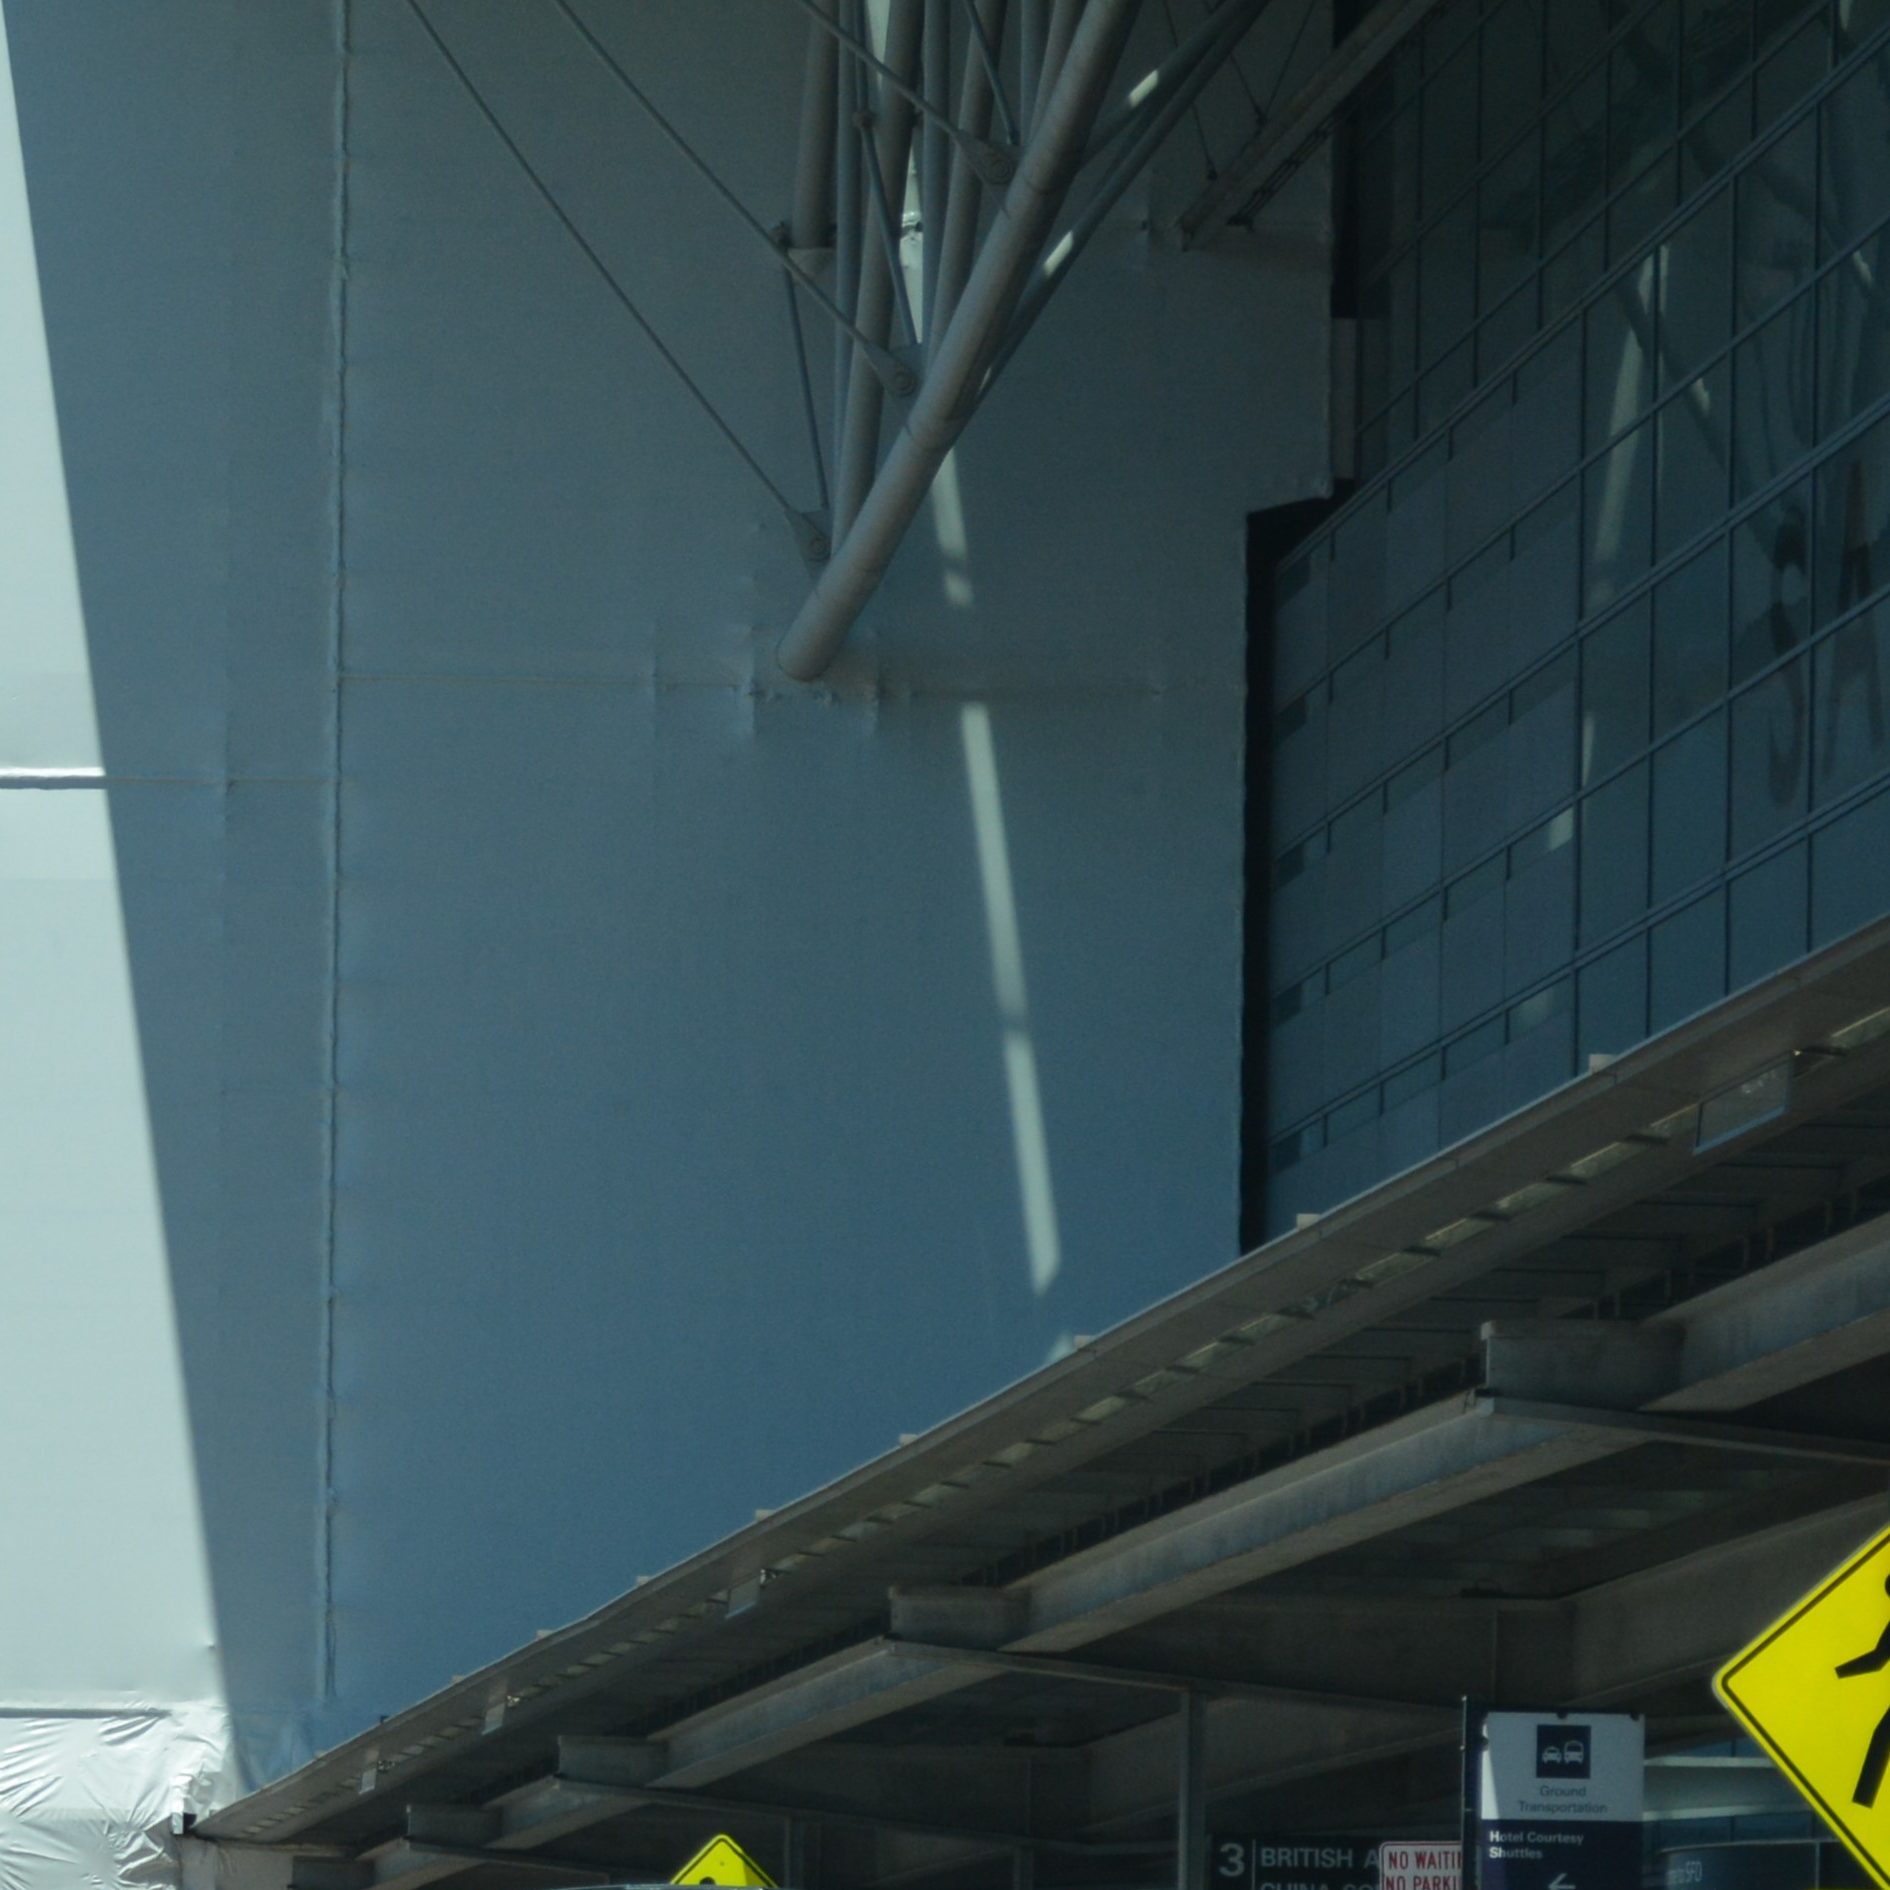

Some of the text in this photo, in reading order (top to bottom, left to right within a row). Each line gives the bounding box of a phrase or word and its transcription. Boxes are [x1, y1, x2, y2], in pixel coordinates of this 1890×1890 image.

[1539, 1785, 1587, 1797] Ground
[1519, 1800, 1607, 1815] Transportation
[1489, 1830, 1584, 1846] Hotel Courtesy
[1220, 1842, 1245, 1877] 3
[1260, 1847, 1353, 1868] BRITISH
[1388, 1851, 1461, 1870] NO WAITI
[1489, 1846, 1543, 1859] Shuttles
